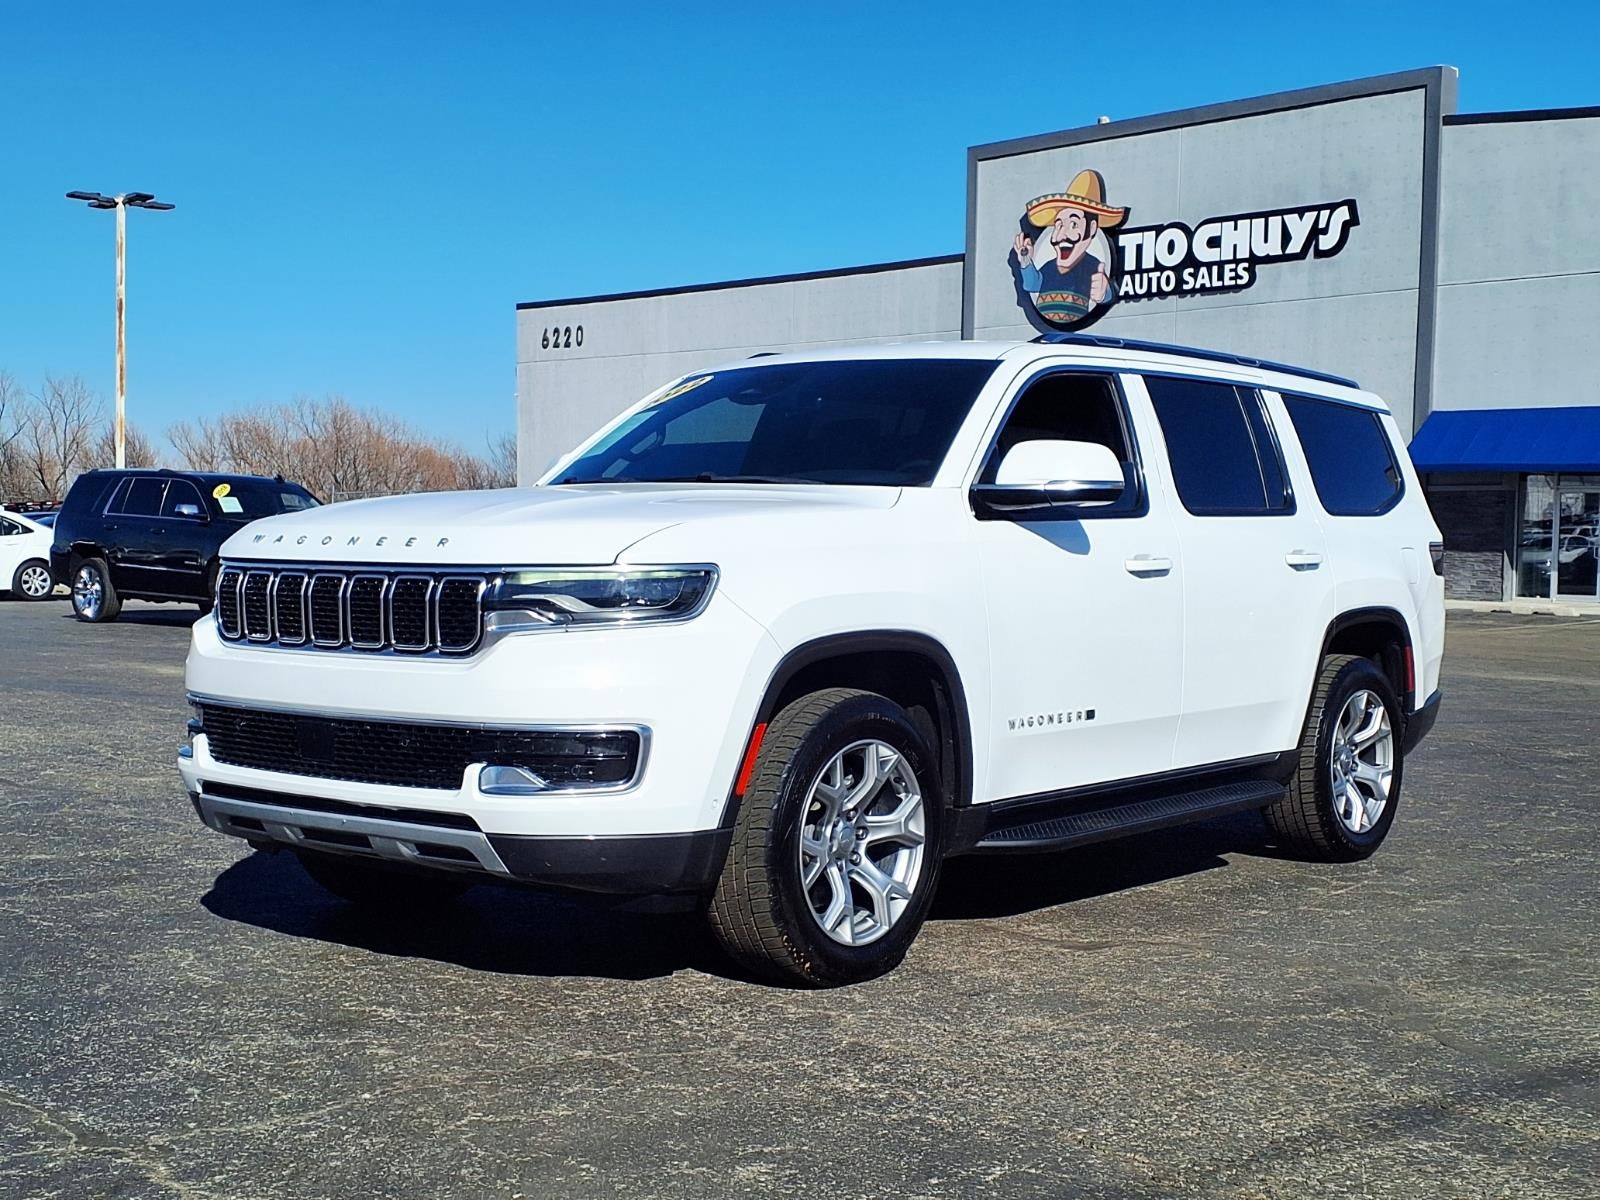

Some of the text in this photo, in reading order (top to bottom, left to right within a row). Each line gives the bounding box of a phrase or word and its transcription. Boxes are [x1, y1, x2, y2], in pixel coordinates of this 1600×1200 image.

[1119, 205, 1351, 270] TIO CHUY'S
[1119, 262, 1249, 296] AUTO SALES
[542, 325, 583, 349] 6220
[253, 534, 449, 548] WAGONEER
[1008, 710, 1083, 730] WAGONEER
